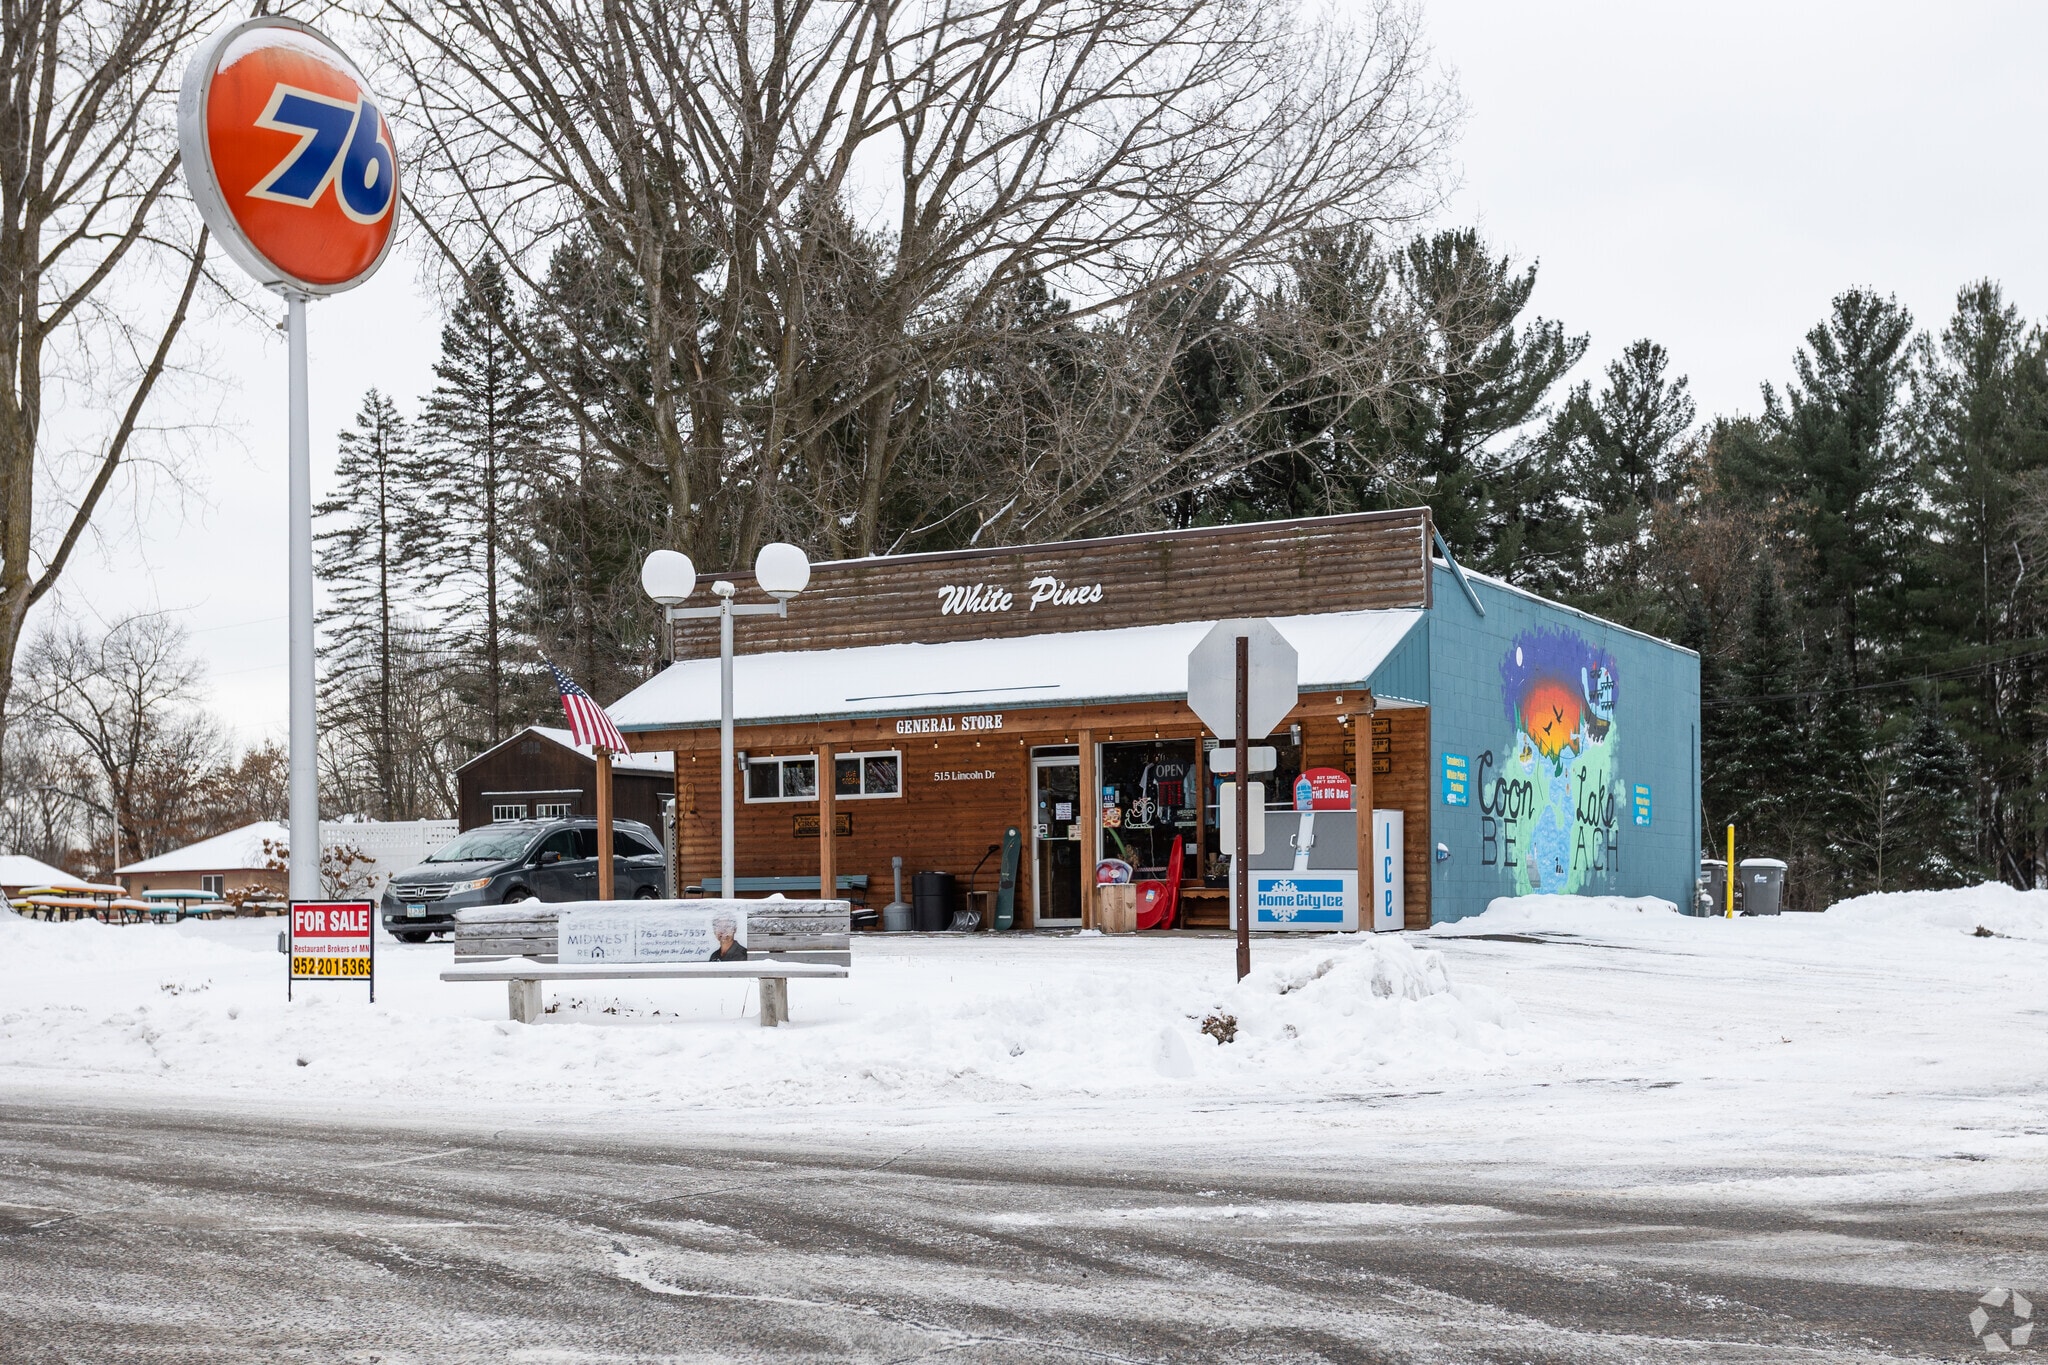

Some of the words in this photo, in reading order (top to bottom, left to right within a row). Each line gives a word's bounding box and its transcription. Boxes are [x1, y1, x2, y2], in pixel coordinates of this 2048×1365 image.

[245, 82, 396, 225] 76
[938, 583, 1014, 615] White
[1028, 575, 1103, 612] Pines
[896, 717, 956, 734] GENERAL
[961, 714, 1003, 731] STORE
[934, 771, 950, 781] 515
[951, 770, 983, 781] Lincoln
[985, 770, 996, 779] Dr
[1156, 764, 1184, 777] OPEN
[1312, 789, 1323, 799] THE
[1324, 788, 1335, 799] BIG
[1336, 788, 1349, 799] BAG
[1476, 750, 1534, 819] Coon
[1576, 765, 1616, 828] Lake
[1258, 893, 1295, 907] Home
[1296, 893, 1321, 909] City
[1323, 894, 1343, 907] Ice
[295, 910, 326, 932] FOR
[329, 910, 368, 932] SALE
[567, 933, 629, 945] MIDWEST
[294, 944, 326, 953] Restaurant
[327, 944, 350, 953] Brokers
[351, 944, 358, 953] of
[359, 944, 370, 953] MN
